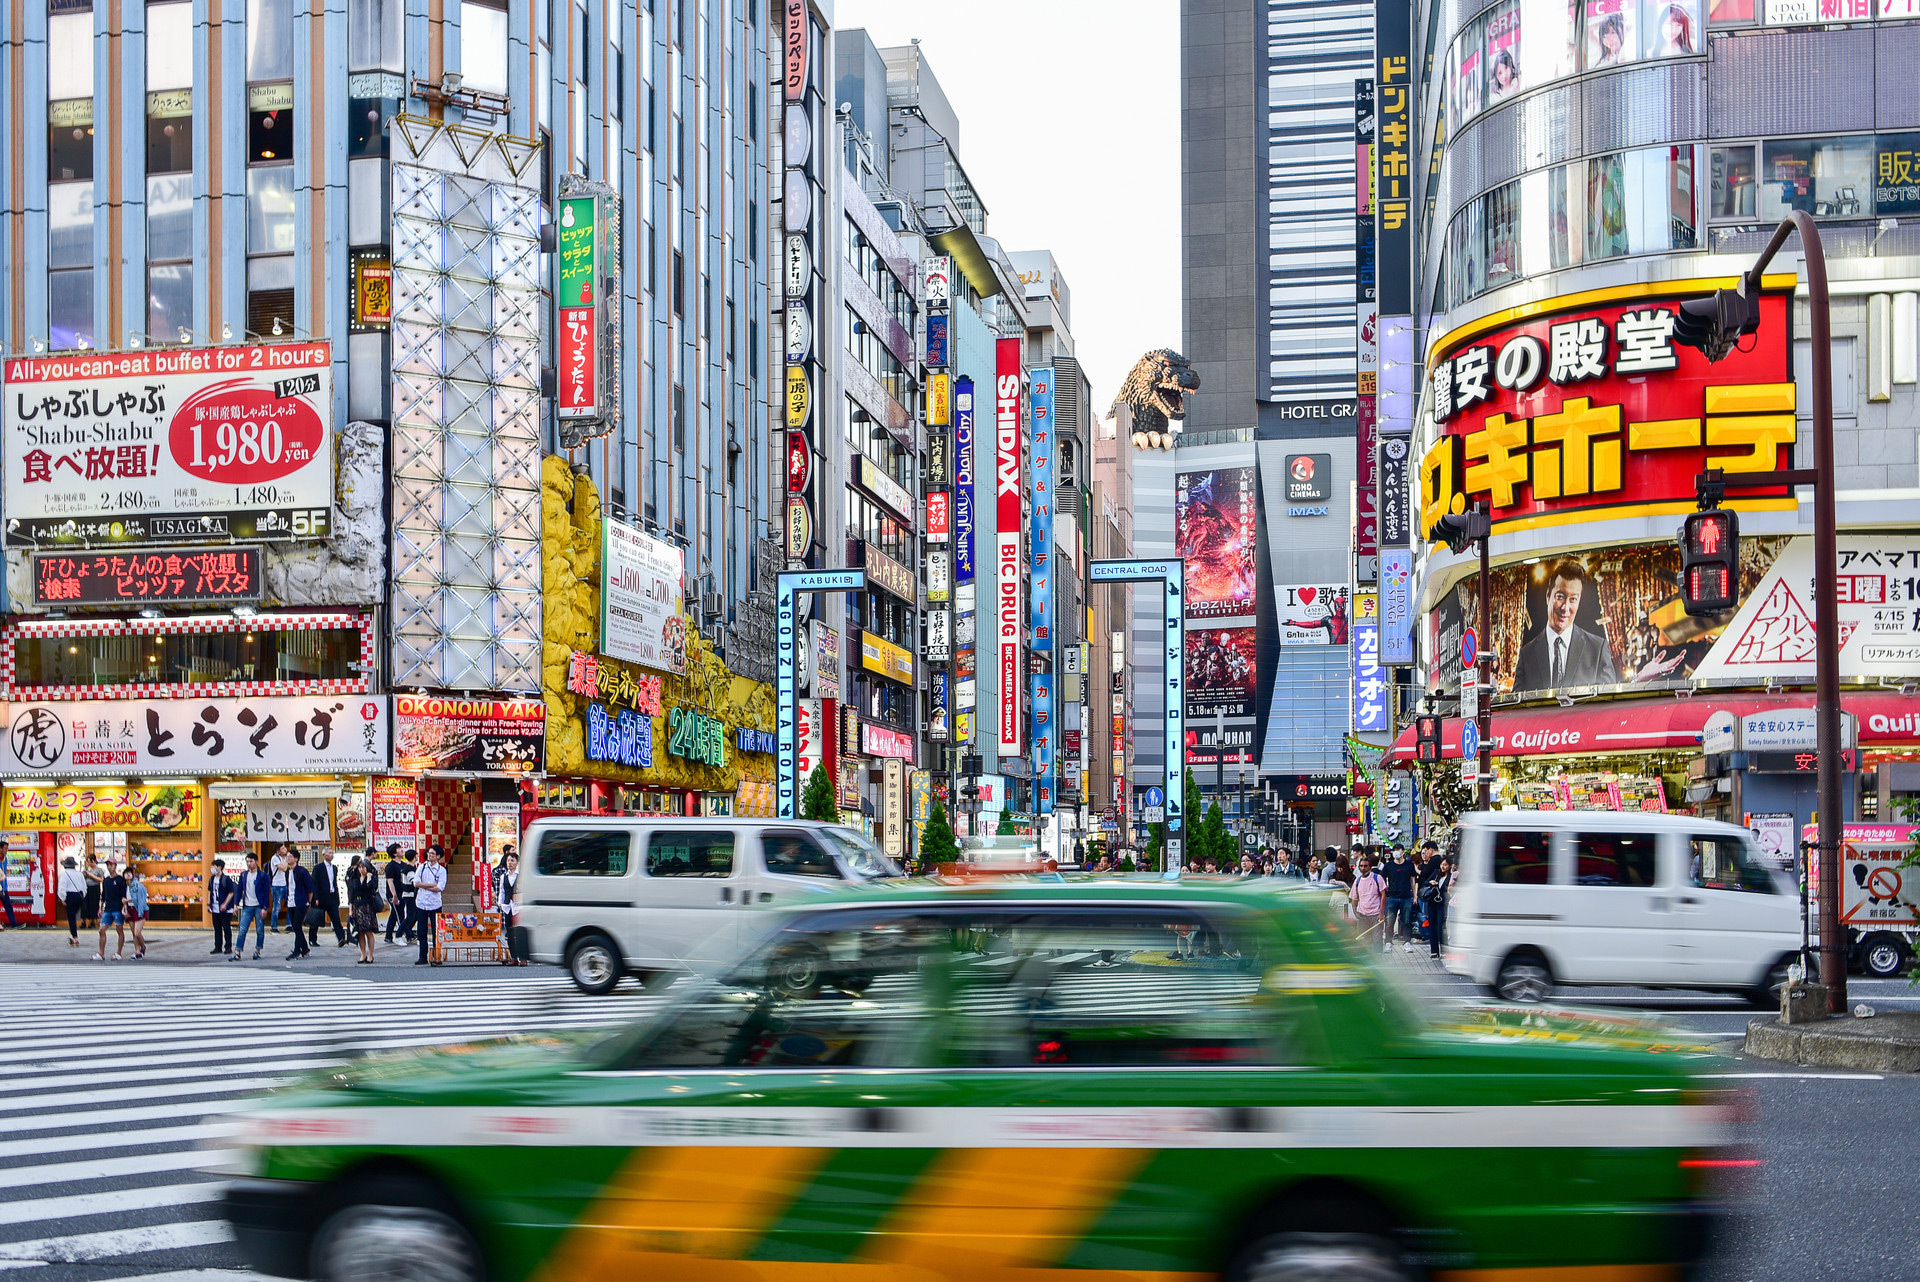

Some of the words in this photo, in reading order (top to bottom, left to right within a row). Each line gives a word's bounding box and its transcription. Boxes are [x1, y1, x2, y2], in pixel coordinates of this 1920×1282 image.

[1770, 11, 1813, 23] STAGE
[1774, 2, 1808, 14] IDOL
[251, 86, 278, 98] Shabu
[265, 95, 293, 106] Shabu
[1382, 56, 1408, 230] ドン・キホーテ
[562, 245, 592, 261] サラダ
[573, 259, 581, 267] と
[561, 264, 593, 280] スイーツ
[366, 279, 387, 310] 虎の子
[788, 285, 802, 295] 6F
[568, 311, 588, 322] 新宿
[927, 323, 947, 365] 海の家
[11, 354, 150, 381] All-you-can-eat
[156, 350, 213, 374] buffet
[216, 347, 244, 370] for
[251, 348, 263, 368] 2
[270, 345, 325, 366] hours
[566, 320, 588, 405] ひょうたん
[1433, 308, 1679, 424] 驚安の殿堂
[277, 375, 317, 399] 120分
[790, 382, 806, 413] 虎の子
[17, 383, 166, 420] しゃぶしゃぶ
[572, 407, 585, 416] 7F
[789, 417, 800, 425] 4F
[1281, 405, 1328, 420] HOTEL
[997, 373, 1020, 498] SHIDAX
[190, 420, 283, 473] 1,980
[284, 447, 310, 463] yen
[233, 485, 277, 506] 1,480
[277, 492, 296, 505] yen
[1290, 484, 1313, 492] TOHO
[1290, 490, 1321, 498] CINEMAS
[100, 490, 143, 511] 2,480
[143, 497, 161, 509] yen
[1178, 474, 1189, 538] 起動する。
[1384, 460, 1400, 541] かんかん商店
[1288, 506, 1329, 517] IMAX
[291, 510, 327, 535] 5F
[957, 495, 973, 562] SHINJUKU
[1001, 544, 1016, 578] BIC
[1093, 566, 1140, 576] CENTRAL
[1141, 563, 1168, 574] ROAD
[195, 573, 250, 595] パスタ
[619, 565, 641, 595] 1,600
[651, 577, 671, 606] 1,700
[1837, 576, 1882, 603] 日曜
[1889, 577, 1901, 602] よる
[933, 590, 944, 600] 3F
[1286, 588, 1296, 606] I
[1396, 589, 1406, 620] IDOL
[1772, 591, 1790, 618] リ
[1001, 581, 1016, 638] DRUG
[1387, 589, 1396, 627] STAGE
[1874, 610, 1905, 621] 4/15
[1286, 631, 1305, 639] 6月1日
[1757, 614, 1809, 640] アル
[1874, 623, 1905, 631] START
[1005, 645, 1013, 661] BIC
[779, 610, 792, 729] GODZILLA
[1358, 627, 1386, 727] カラオケ
[932, 673, 945, 706] 海の家
[1167, 616, 1181, 781] ゴジラロード
[399, 699, 493, 718] OKONOMI
[500, 701, 546, 719] YAKI
[146, 702, 345, 758] とらそば
[457, 726, 480, 735] Drinks
[481, 726, 492, 735] for
[499, 727, 520, 736] hours
[482, 719, 498, 728] with
[76, 742, 103, 750] TORA
[107, 741, 134, 749] SOBA
[586, 702, 653, 768] 飲み放題
[1202, 730, 1252, 747] MAUHAN
[1464, 729, 1472, 755] P
[1511, 728, 1581, 750] Quijote
[1748, 738, 1762, 746] Safety
[1763, 738, 1779, 746] Station
[1064, 751, 1080, 759] Cafe
[485, 762, 522, 771] TORADYU
[779, 743, 793, 799] ROAD
[10, 790, 148, 810] とんこつラーメン
[1310, 785, 1339, 796] TOHO
[1387, 778, 1402, 841] カラオケ
[251, 808, 331, 833] とらそば
[1869, 908, 1897, 918] 新宿区
